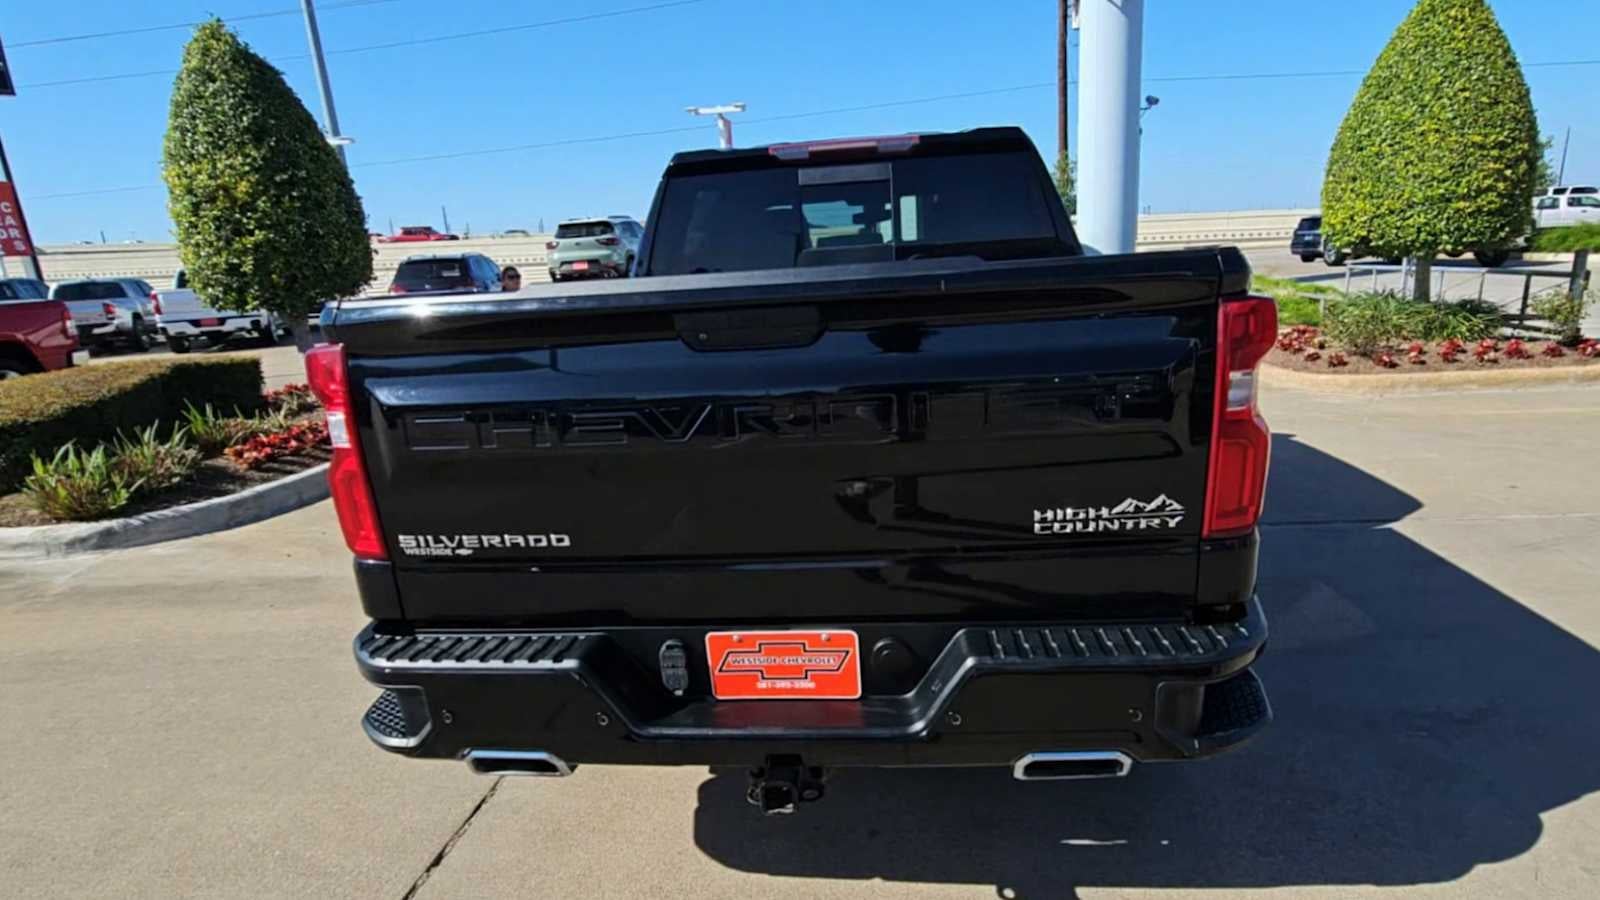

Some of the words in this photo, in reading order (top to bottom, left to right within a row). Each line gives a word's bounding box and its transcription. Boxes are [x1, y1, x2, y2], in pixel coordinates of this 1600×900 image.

[1033, 506, 1110, 521] HIGH
[1034, 515, 1184, 535] COUNTRY
[398, 534, 571, 548] SILVERADO
[731, 656, 778, 666] WESTSIDE
[782, 655, 837, 665] CHEVROLET
